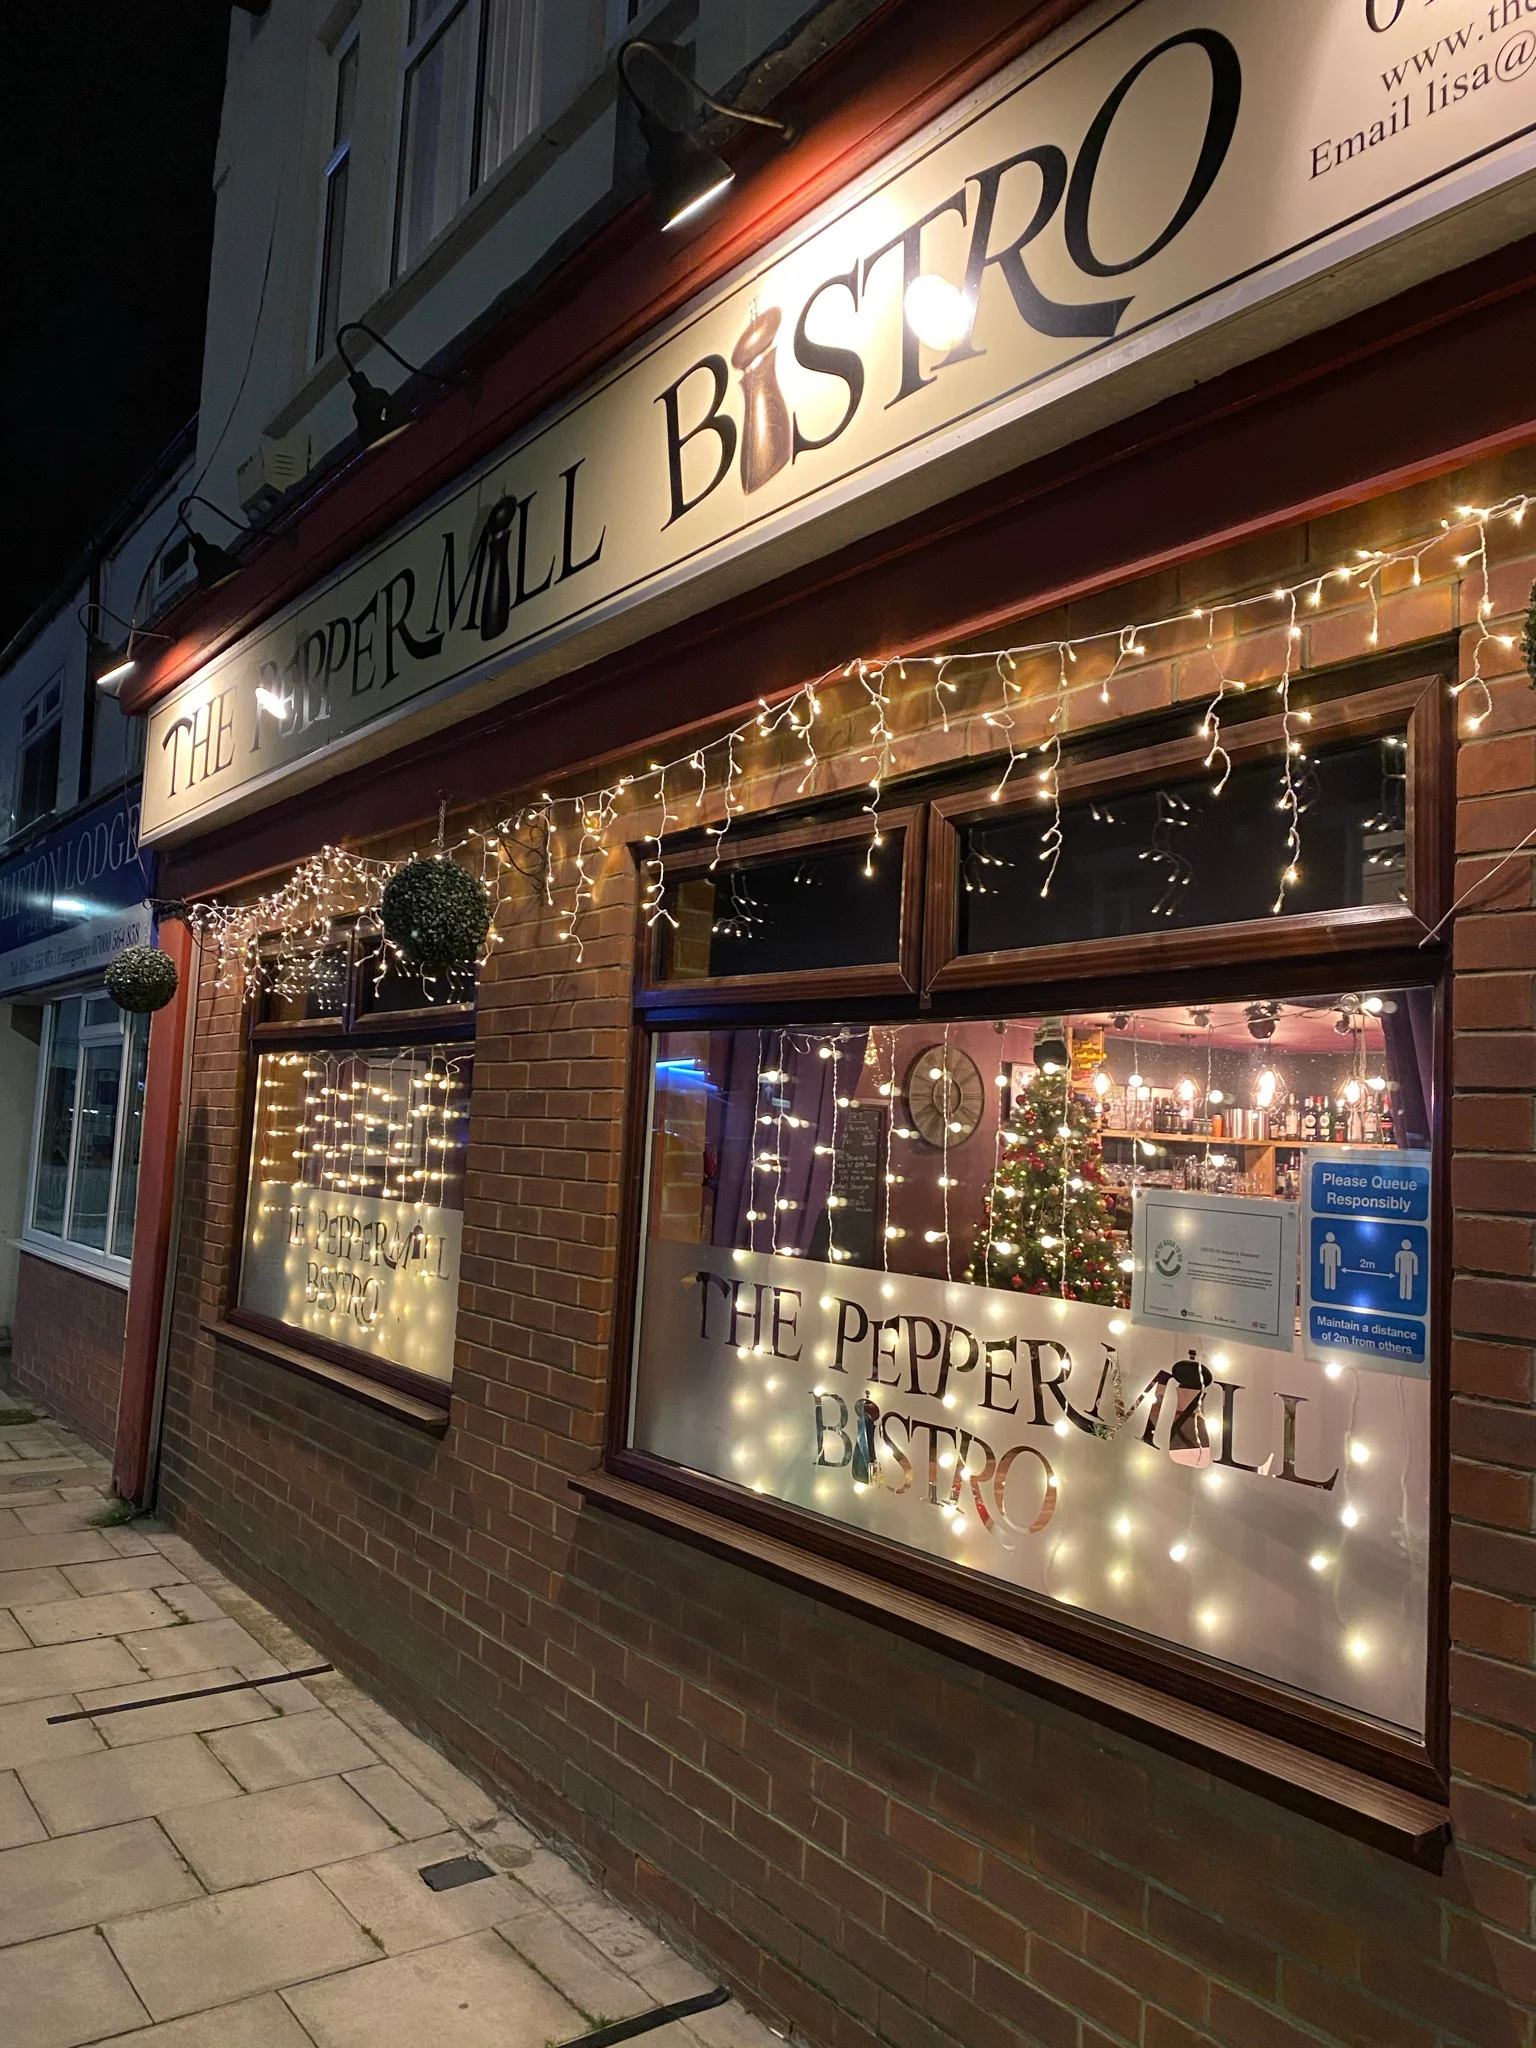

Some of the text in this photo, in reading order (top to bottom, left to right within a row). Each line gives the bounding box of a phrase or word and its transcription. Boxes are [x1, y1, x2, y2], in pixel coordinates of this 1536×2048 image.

[1380, 0, 1536, 92] www.th
[1308, 30, 1536, 181] Email lisa@
[162, 684, 237, 798] THE
[653, 28, 1242, 532] BISTRO
[0, 803, 140, 920] LIFTON LODGE
[1322, 1172, 1417, 1191] Please Queue
[1327, 1192, 1411, 1213] Responsibly
[1359, 1258, 1376, 1270] 2m
[695, 1271, 802, 1361] THE
[1317, 1315, 1417, 1340] Maintain a distance
[1321, 1331, 1413, 1355] of 2m from others
